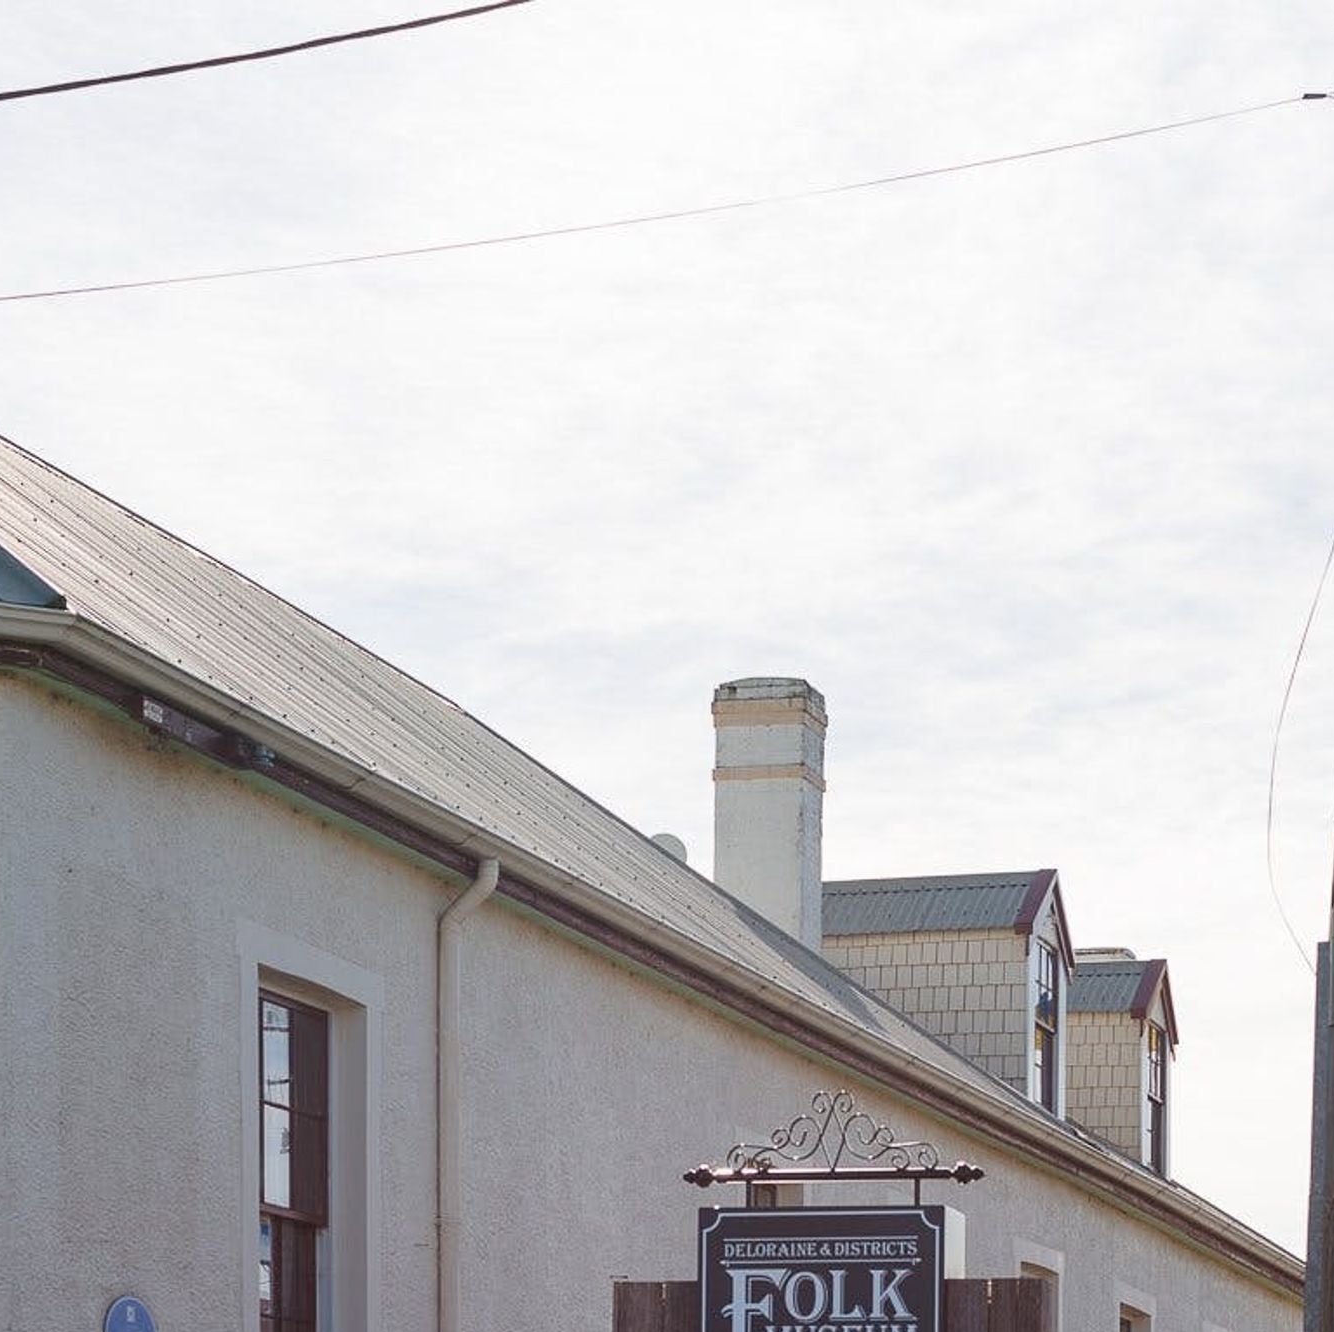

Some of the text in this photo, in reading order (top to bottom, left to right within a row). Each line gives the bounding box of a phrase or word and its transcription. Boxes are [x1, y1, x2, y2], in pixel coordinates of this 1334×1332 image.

[724, 1241, 918, 1258] DELORAINE & DISTRICTS
